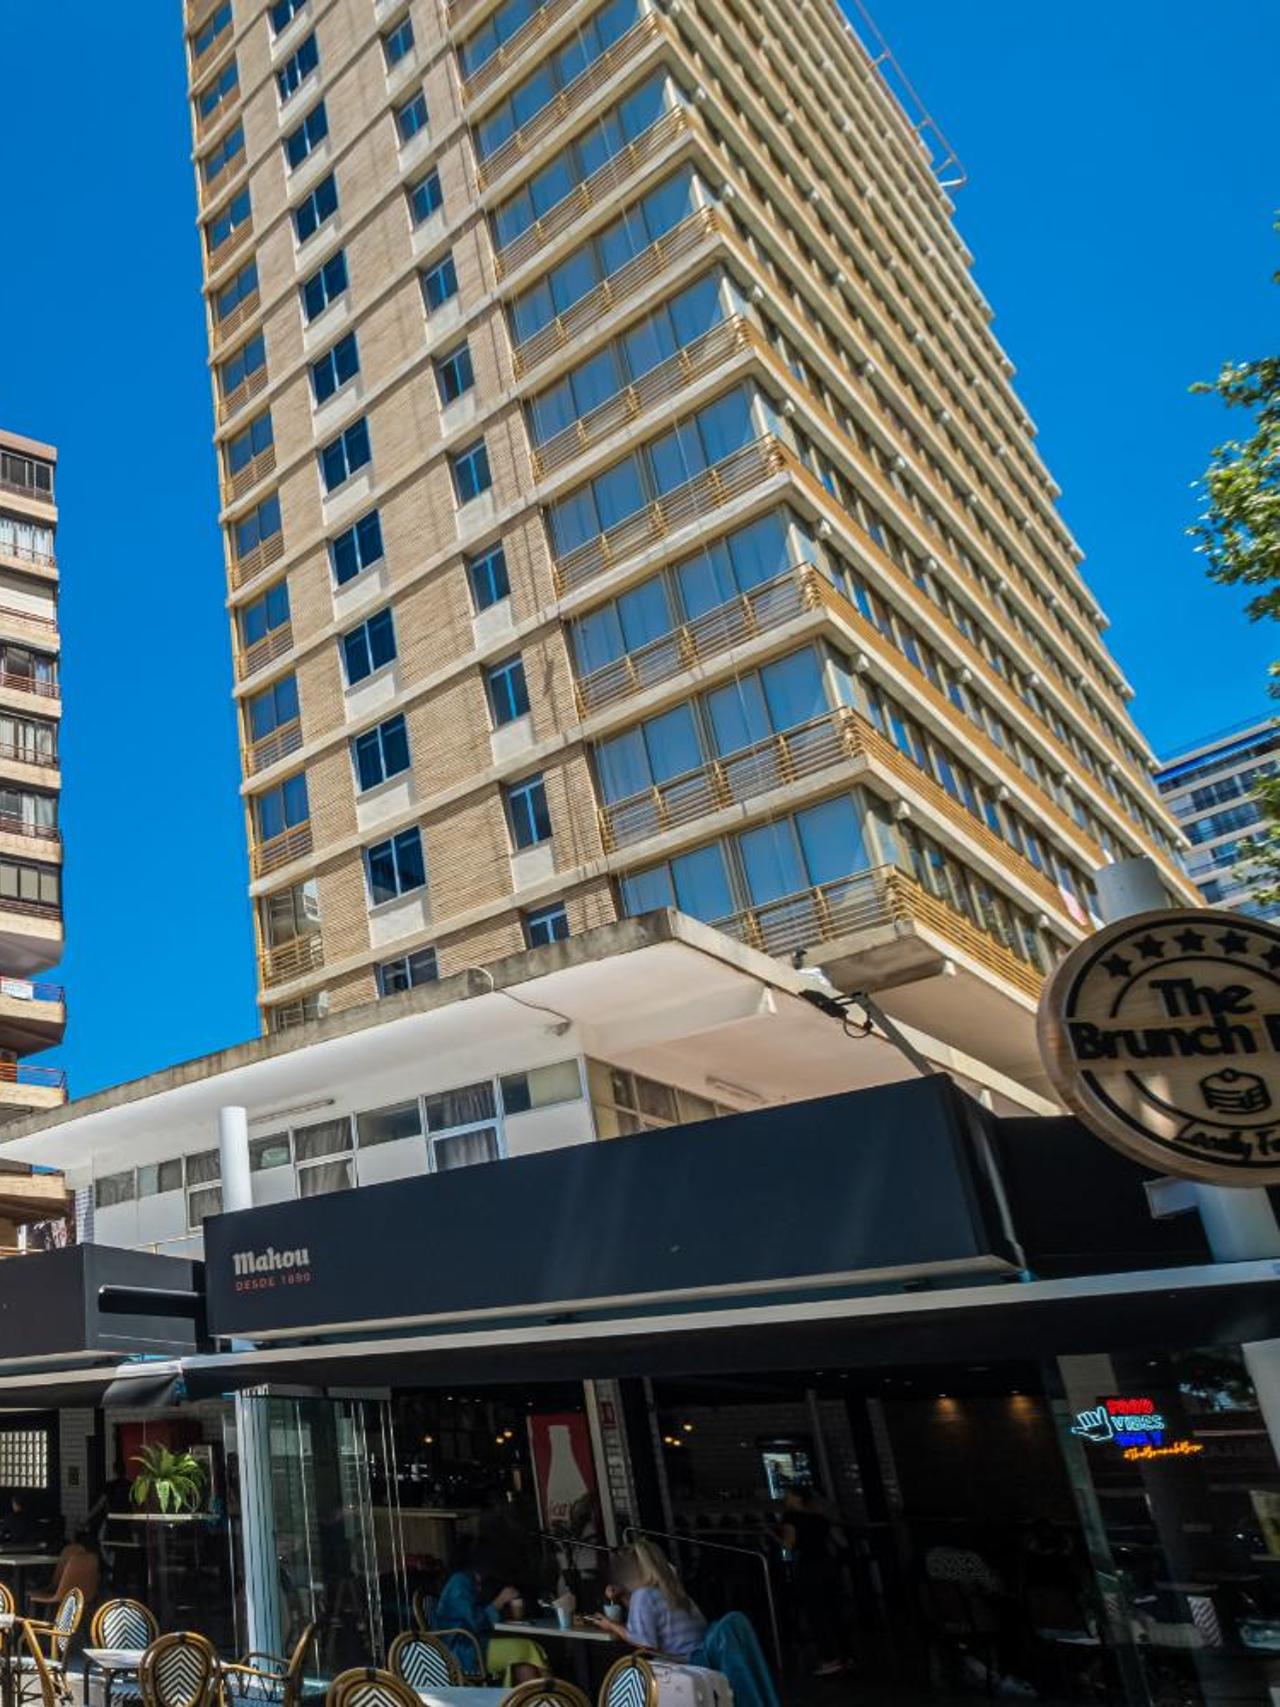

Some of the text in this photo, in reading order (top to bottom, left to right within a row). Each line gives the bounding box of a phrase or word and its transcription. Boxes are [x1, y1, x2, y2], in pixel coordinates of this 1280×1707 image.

[1148, 978, 1256, 1017] The
[1066, 1013, 1257, 1060] Brunch
[232, 1246, 310, 1275] Mahou
